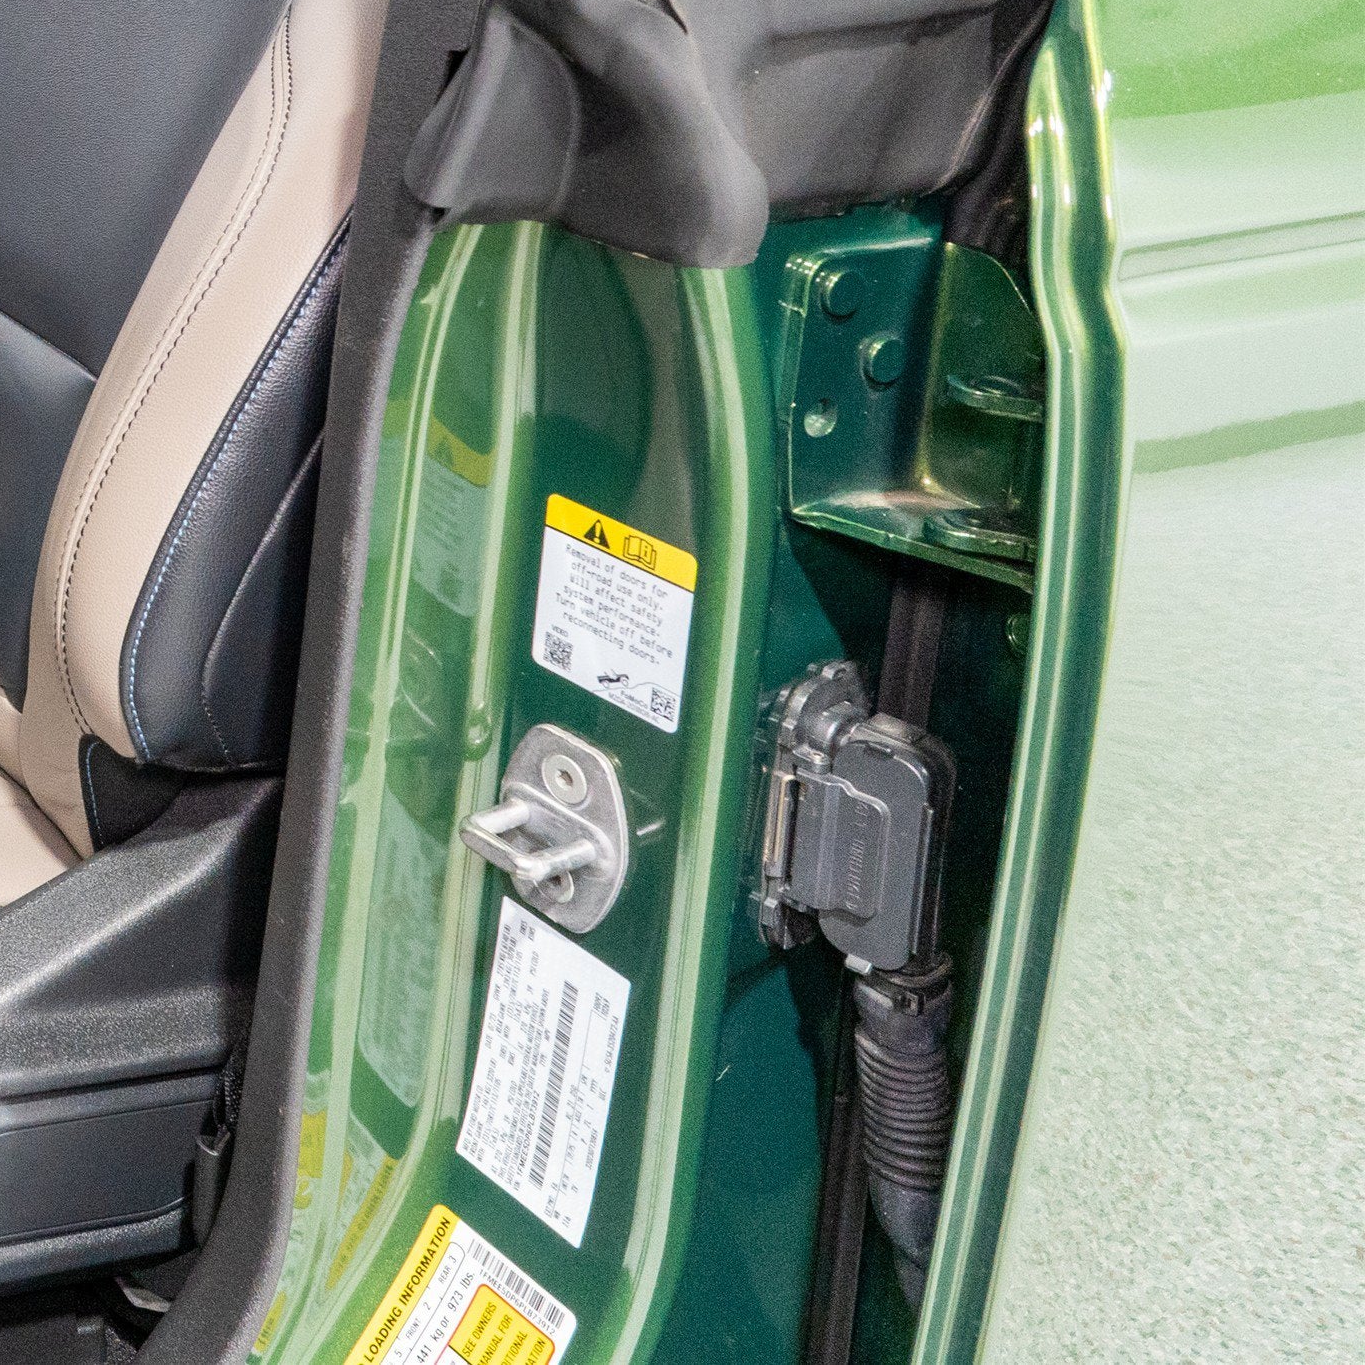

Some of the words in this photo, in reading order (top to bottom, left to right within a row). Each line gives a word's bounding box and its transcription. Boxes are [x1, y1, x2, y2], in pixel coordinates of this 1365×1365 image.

[565, 543, 600, 568] Removal
[604, 561, 614, 575] of
[619, 569, 646, 590] doors
[651, 584, 668, 599] for
[571, 560, 612, 587] off-road
[616, 583, 632, 597] use
[563, 584, 594, 607] system
[595, 585, 625, 608] affect
[630, 602, 662, 627] safety
[555, 592, 575, 610] Turn
[580, 605, 615, 630] vehicle
[619, 624, 634, 639] off
[639, 634, 672, 658] before
[563, 611, 624, 650] reconnecting
[436, 1264, 452, 1284] REAR
[448, 1254, 457, 1263] 3
[363, 1304, 402, 1363] LOADING
[398, 1216, 451, 1306] INFORMATION
[405, 1317, 421, 1340] FRONT
[422, 1301, 431, 1310] 2
[415, 1343, 432, 1365] 441
[429, 1325, 444, 1343] kg
[439, 1314, 450, 1328] or
[446, 1289, 464, 1312] 973
[458, 1268, 475, 1289] lbs.
[461, 1338, 476, 1357] SEE
[470, 1301, 497, 1340] OWNERS
[497, 1313, 513, 1334] FOR
[394, 1348, 403, 1358] 5
